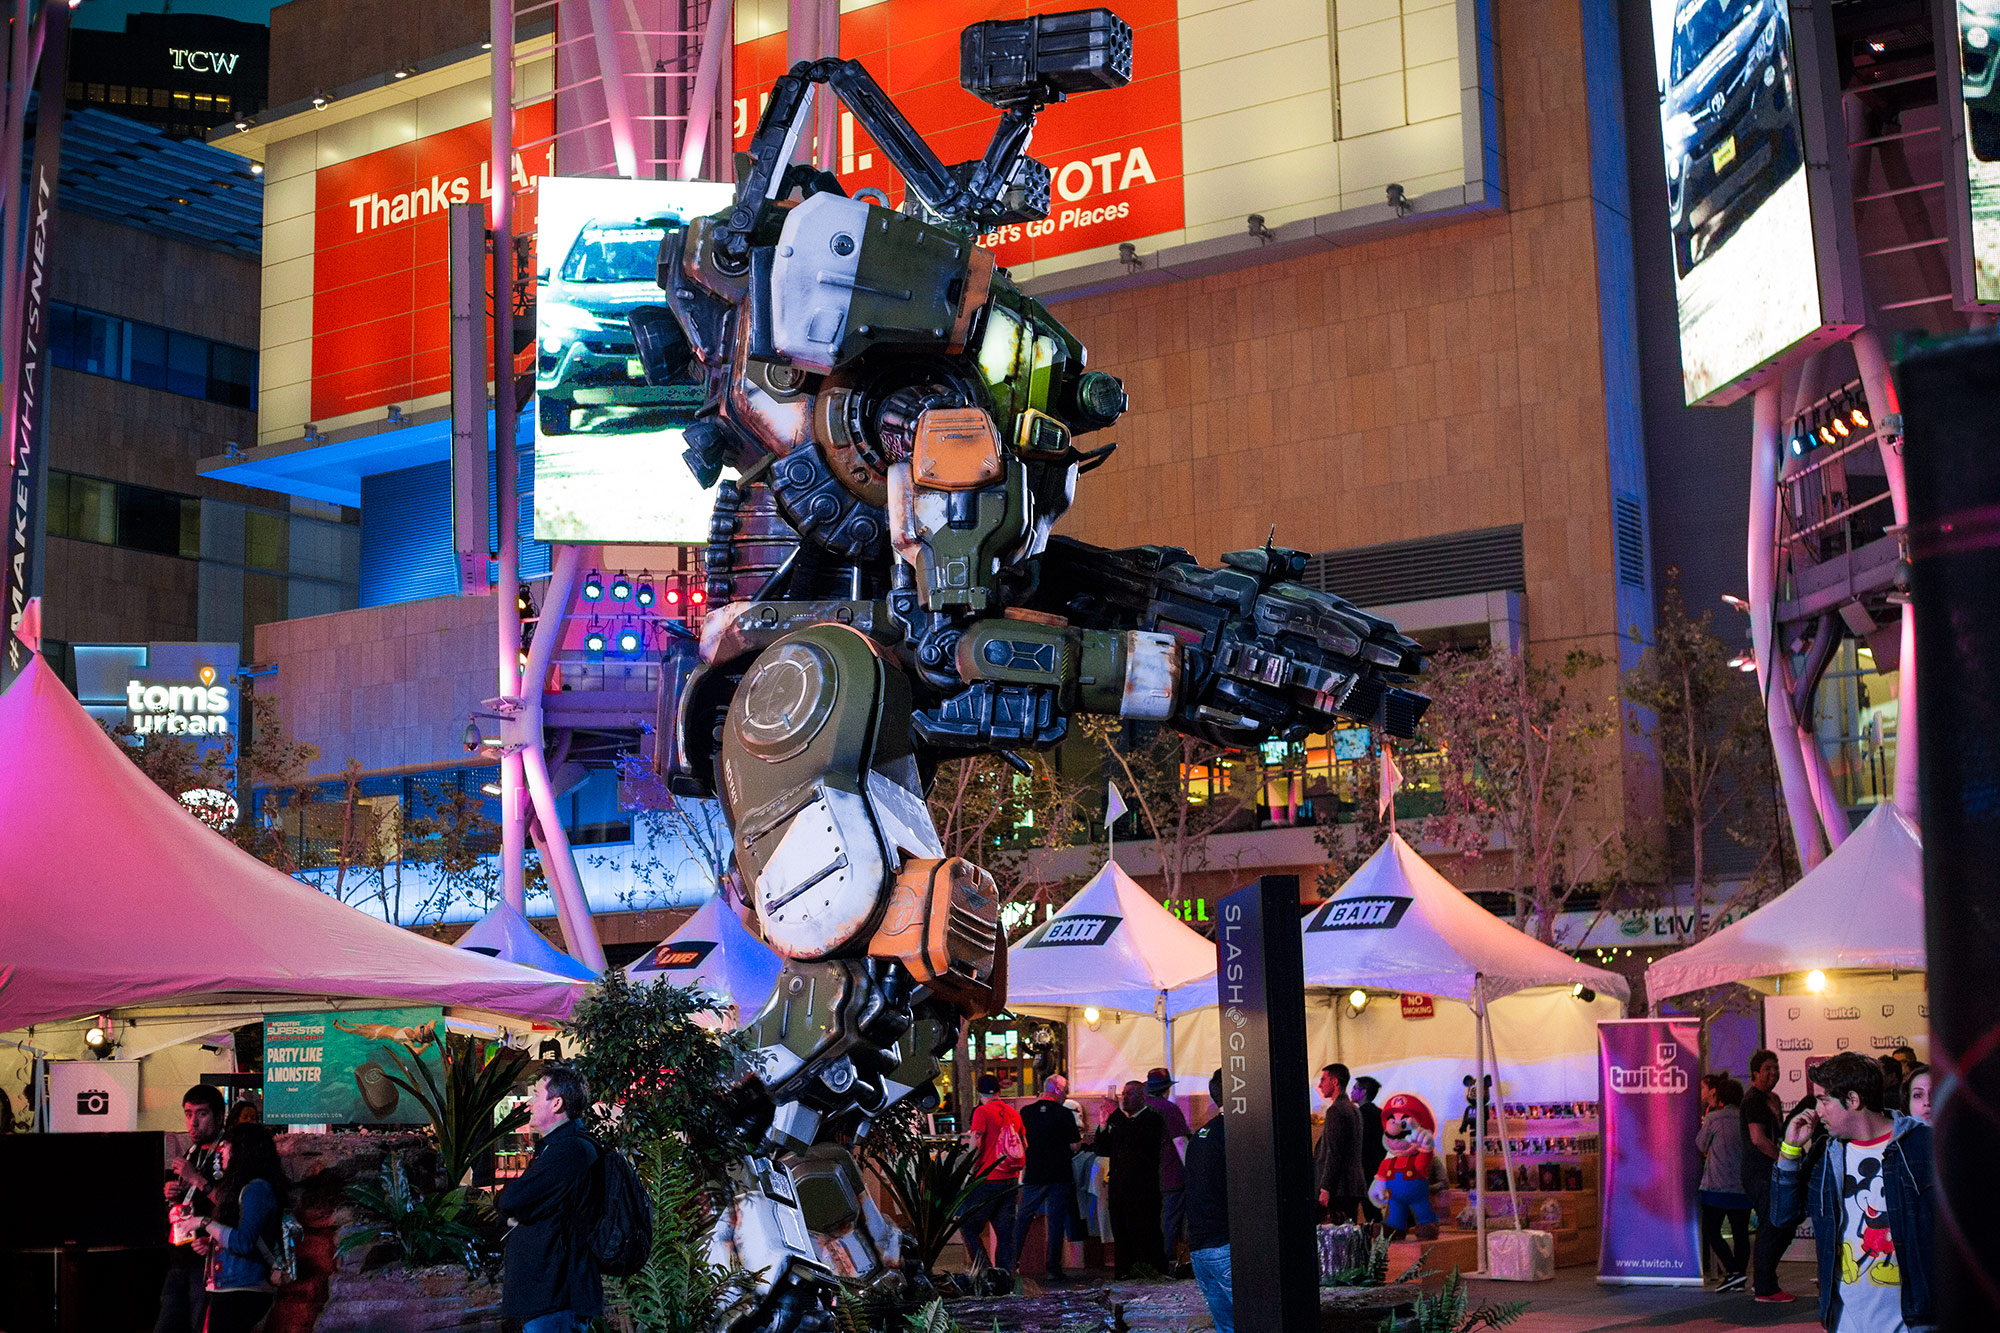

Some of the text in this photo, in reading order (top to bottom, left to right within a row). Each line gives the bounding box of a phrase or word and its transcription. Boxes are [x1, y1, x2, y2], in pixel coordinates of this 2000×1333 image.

[169, 48, 239, 74] TCW
[350, 175, 470, 234] Thanks
[1026, 215, 1055, 238] Go
[1059, 201, 1130, 232] Places
[133, 714, 228, 735] urban
[1333, 906, 1386, 921] BAIT
[1048, 924, 1097, 938] BAIT
[1408, 995, 1423, 1006] NO
[1225, 904, 1247, 1115] SLASH GEAR
[1403, 1006, 1433, 1015] SMOKING
[1824, 1007, 1860, 1020] twitch
[267, 1026, 325, 1035] SUPERSTAR
[1776, 1039, 1813, 1051] twitch
[1870, 1036, 1908, 1049] twitch
[267, 1047, 323, 1063] PARTY LIKE
[267, 1067, 321, 1082] A MONSTER
[1610, 1066, 1688, 1094] twitch
[1616, 1259, 1684, 1269] www.twitch.tv
